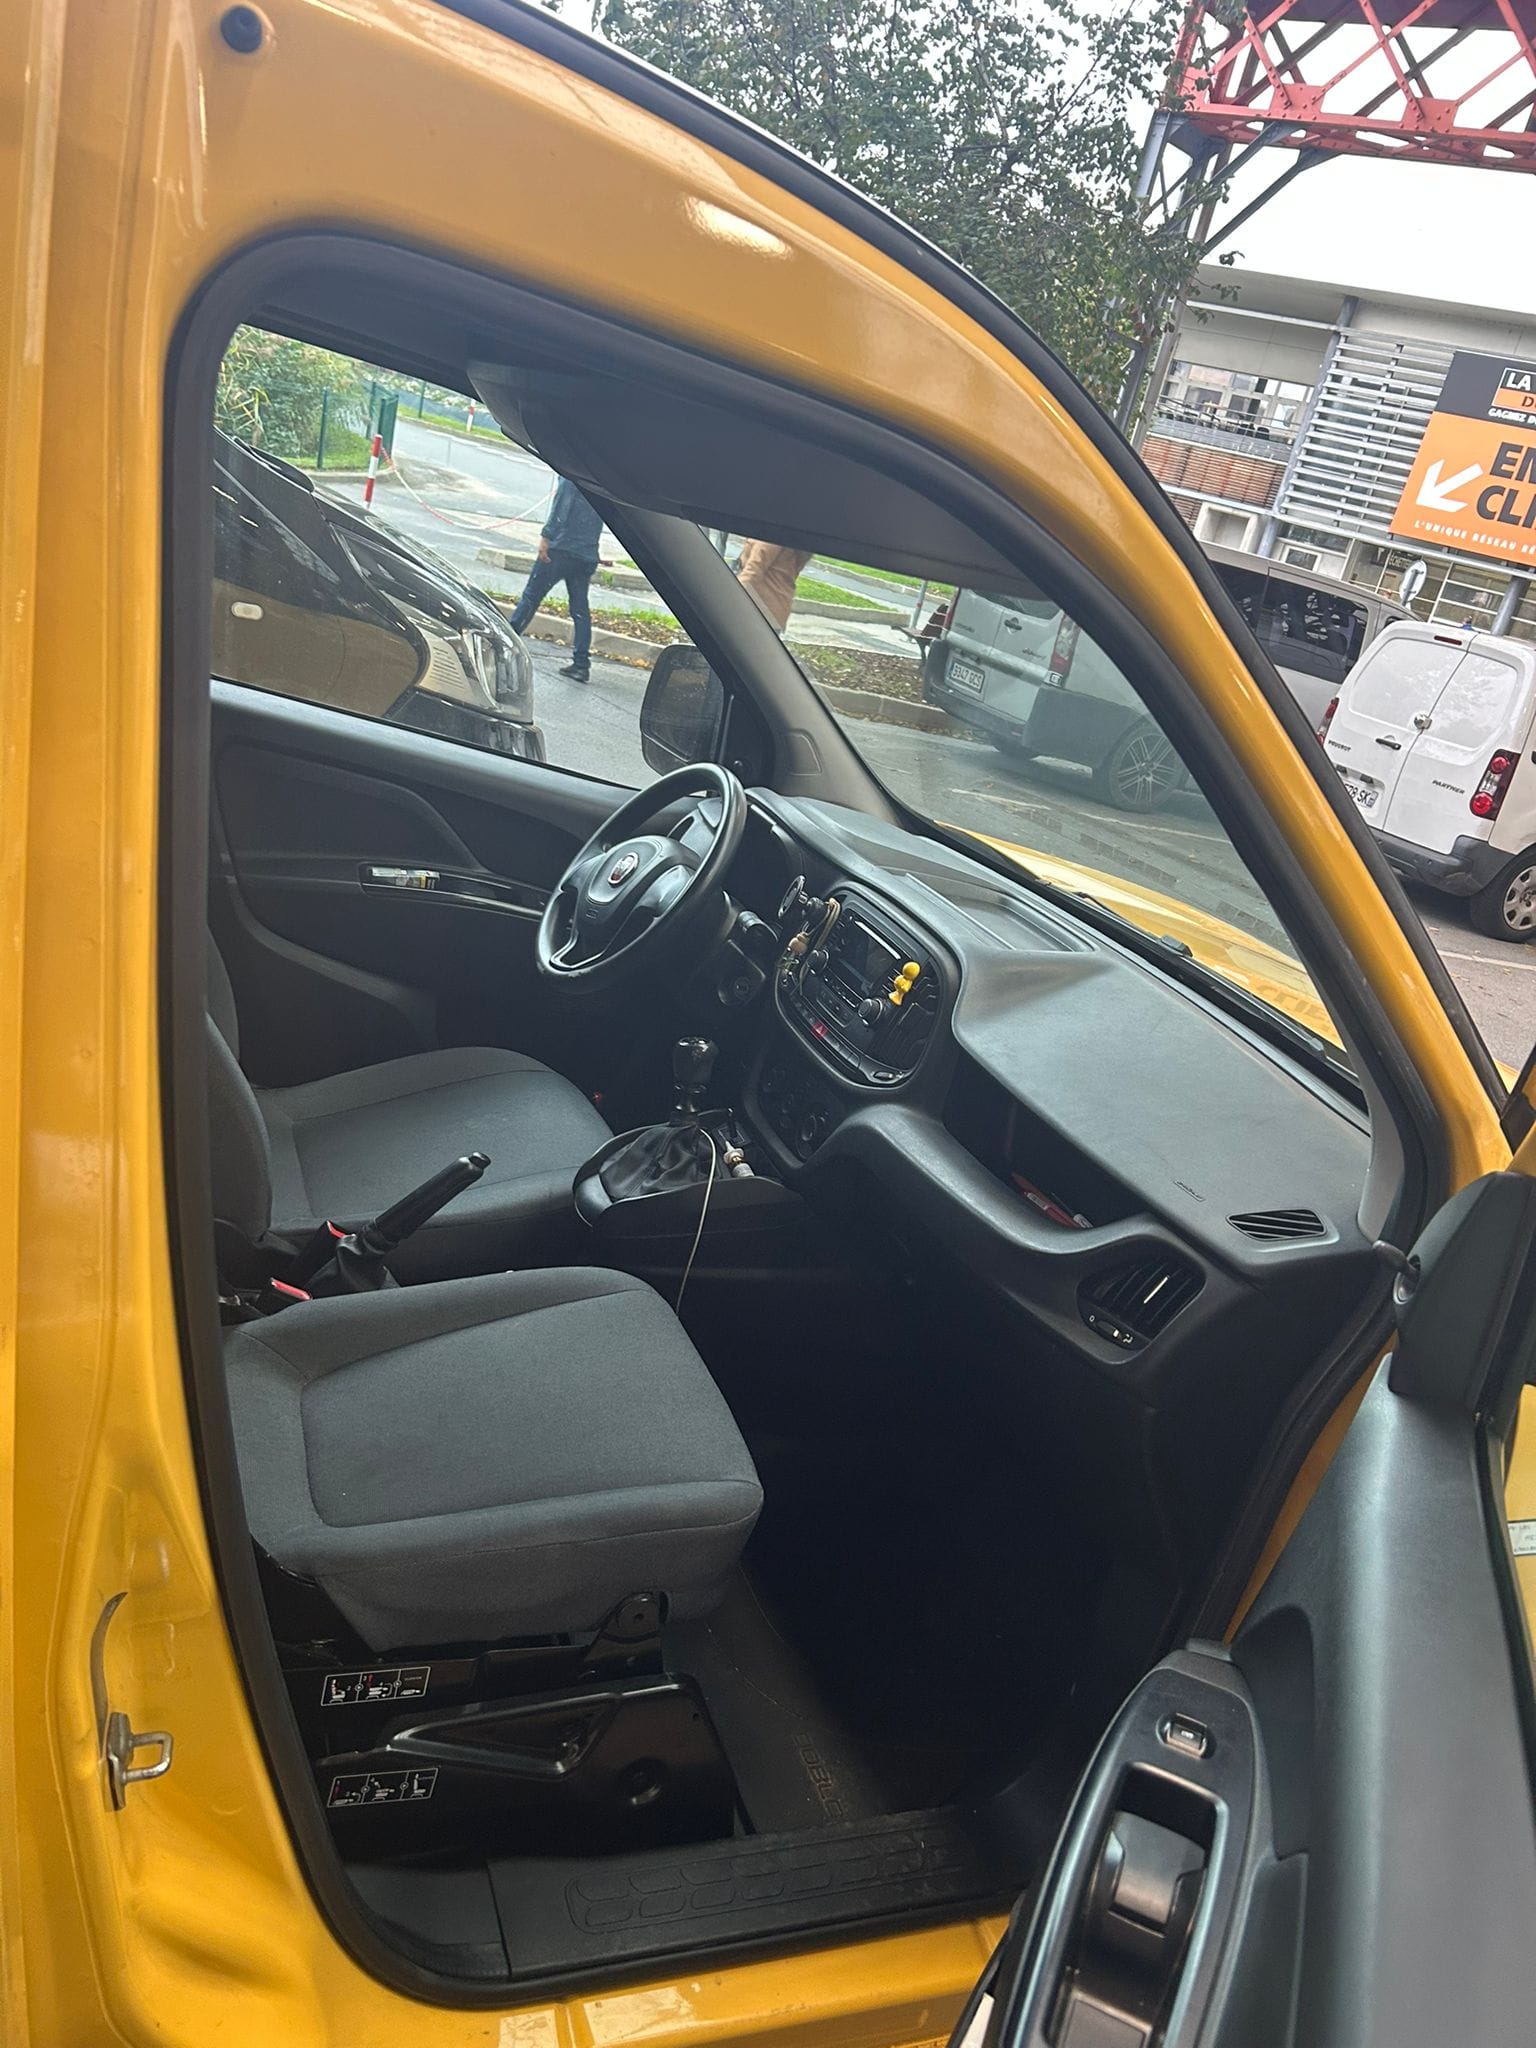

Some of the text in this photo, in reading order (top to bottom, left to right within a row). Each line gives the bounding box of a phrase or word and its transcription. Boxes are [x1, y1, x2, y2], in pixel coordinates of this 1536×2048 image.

[1506, 372, 1531, 391] LA
[1521, 395, 1536, 408] D
[1488, 408, 1536, 424] GAGNEZ D
[1475, 484, 1536, 529] CLI
[1414, 520, 1467, 540] L'UNIQUE
[1471, 532, 1517, 551] RÉSEAU
[1432, 779, 1465, 795] PARTNER
